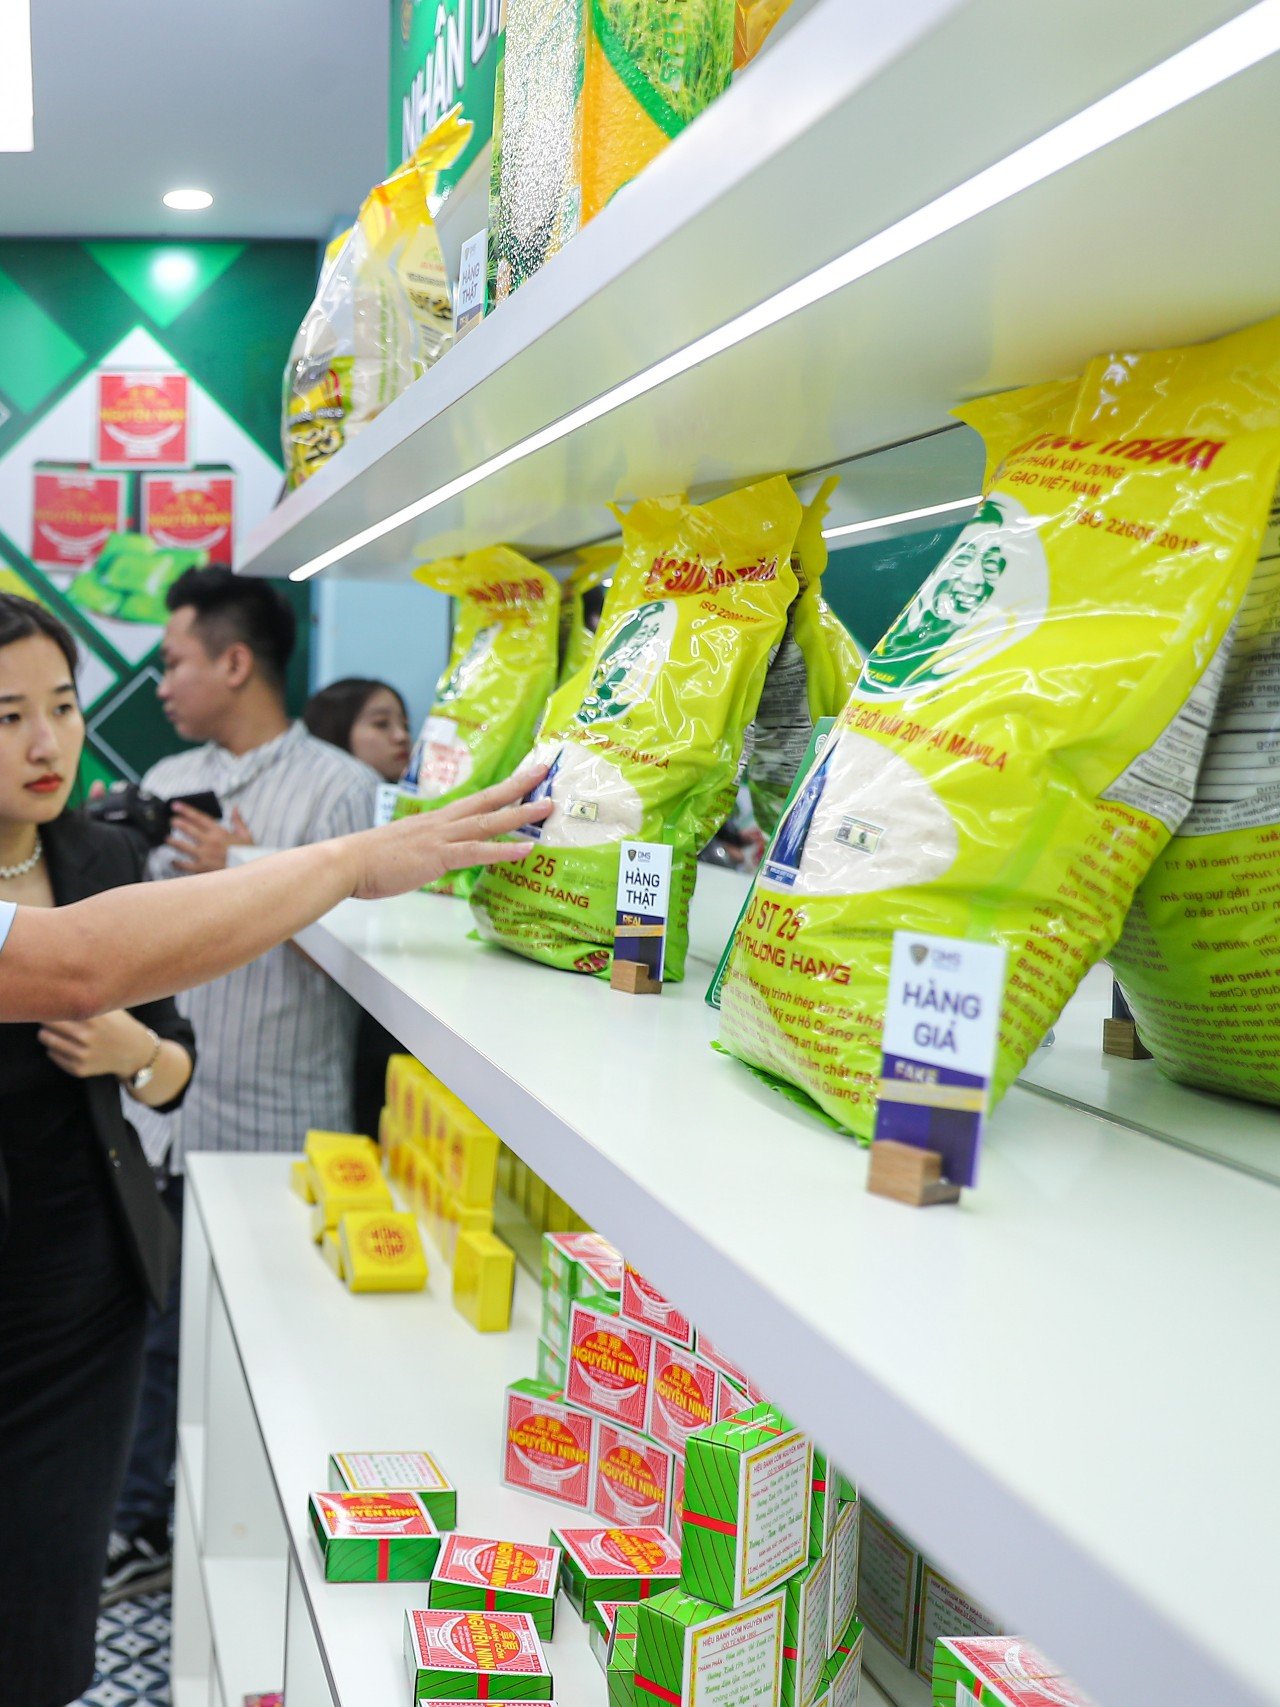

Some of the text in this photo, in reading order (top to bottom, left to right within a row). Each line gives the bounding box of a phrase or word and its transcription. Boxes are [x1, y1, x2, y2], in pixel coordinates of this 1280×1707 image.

[462, 262, 480, 286] HÀNG
[462, 282, 478, 305] THẬT
[1010, 469, 1103, 498] GẠO VIỆT NAM
[1060, 457, 1084, 472] XÂY
[1087, 462, 1126, 480] DỰNG
[946, 732, 1010, 774] MANILA
[532, 853, 557, 878] 25
[624, 867, 661, 888] HÀNG
[625, 888, 657, 910] THẬT
[756, 899, 781, 933] ST
[775, 906, 807, 942] 25
[789, 952, 852, 986] HẠNG
[901, 977, 982, 1021] HÀNG
[572, 1345, 648, 1386] NGUYÊN NINH
[654, 1377, 712, 1421] NGUYÊN NINH
[508, 1427, 590, 1465] NGUYÊN NINH
[599, 1459, 665, 1504] NGUYÊN NINH
[386, 1507, 421, 1519] NINH
[465, 1613, 497, 1669] NGUYÊN NINH
[715, 1629, 730, 1642] BÁNH
[742, 1614, 763, 1631] NGUYÊN
